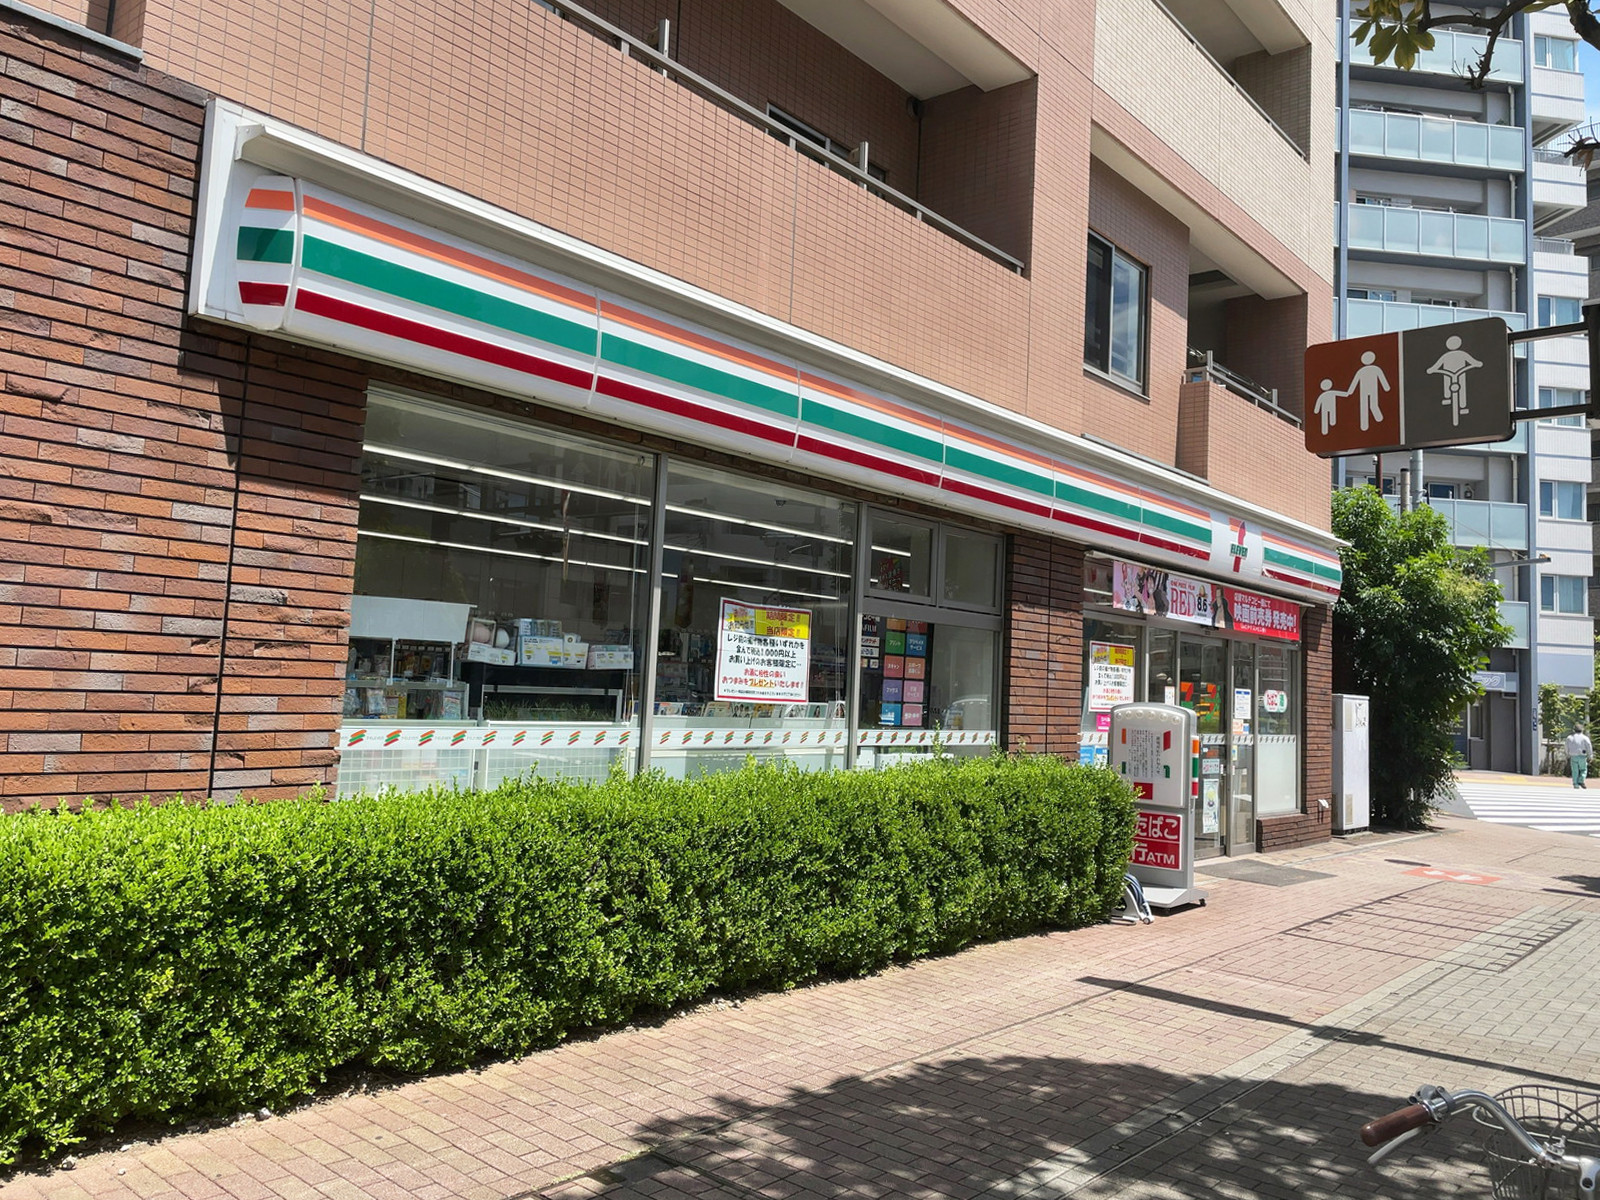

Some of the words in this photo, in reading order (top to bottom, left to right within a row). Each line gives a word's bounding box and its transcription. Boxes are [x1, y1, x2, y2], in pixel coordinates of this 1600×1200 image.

[1170, 587, 1196, 617] RED
[1197, 596, 1208, 612] 8.6
[1136, 815, 1178, 840] たばこ
